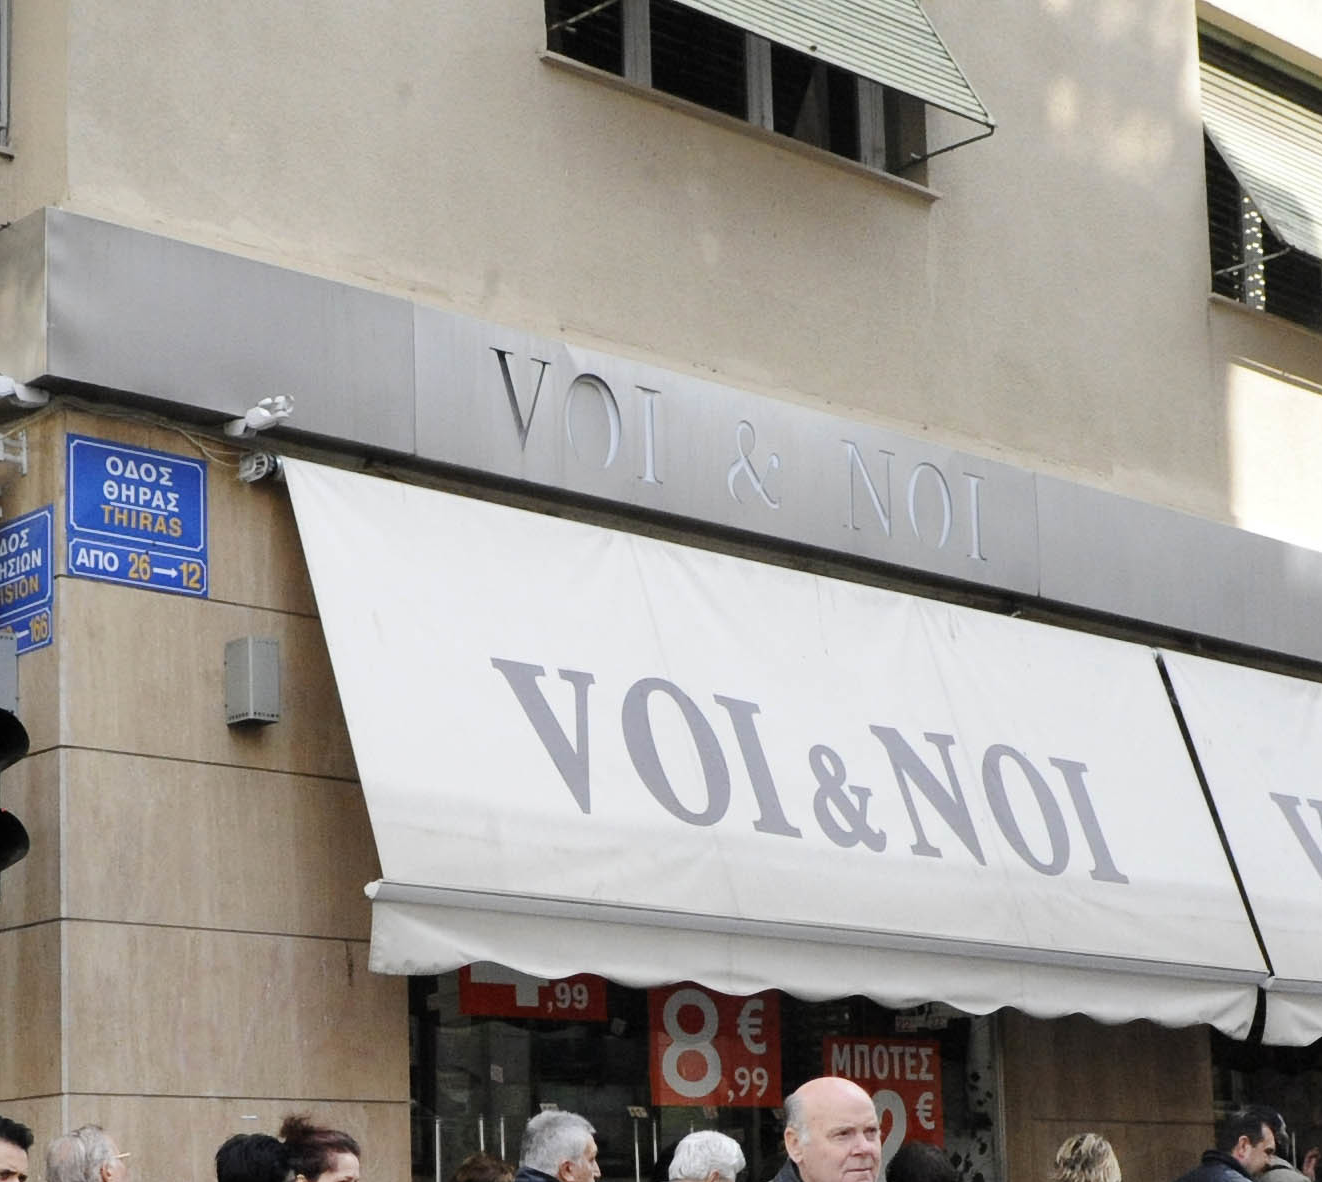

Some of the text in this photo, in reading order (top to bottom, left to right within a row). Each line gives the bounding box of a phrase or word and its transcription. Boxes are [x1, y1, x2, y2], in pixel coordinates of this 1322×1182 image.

[105, 455, 173, 487] ΟΔΟΣ
[489, 346, 988, 562] VOI & NOI
[103, 480, 179, 512] ΘΗΡΑΣ
[100, 503, 183, 537] THIRAS
[76, 548, 202, 588] ΑΠΟ 26 12
[830, 1042, 935, 1081] ΜΠΟΤΕΣ
